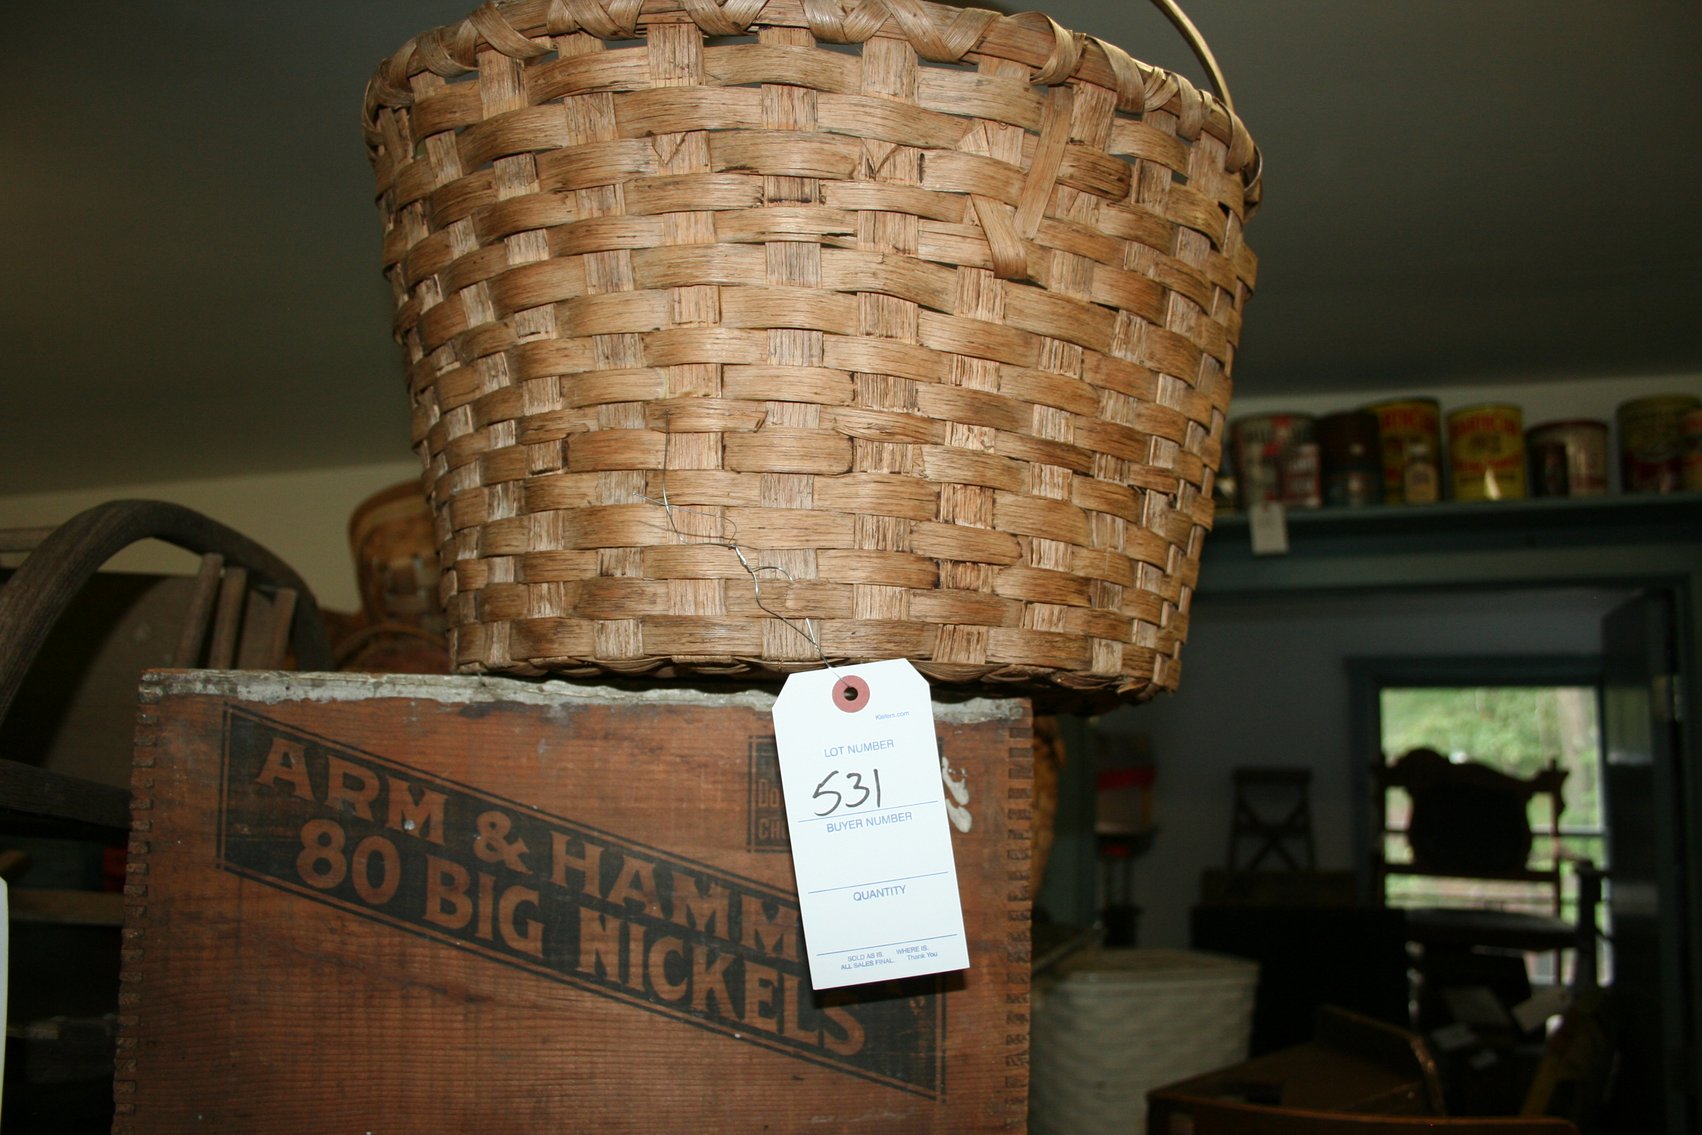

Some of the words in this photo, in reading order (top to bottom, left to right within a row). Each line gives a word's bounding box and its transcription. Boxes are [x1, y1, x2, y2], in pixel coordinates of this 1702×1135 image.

[823, 745, 845, 758] LOT
[847, 739, 895, 755] NUMBER
[812, 768, 881, 817] 531
[826, 819, 864, 833] BUYER
[865, 811, 913, 827] NUMBER
[255, 737, 450, 847] ARM
[473, 810, 534, 875] &
[549, 830, 800, 961] HAMM
[852, 885, 907, 902] QUANTITY
[296, 818, 400, 905] 80
[422, 854, 545, 958] BIG
[576, 906, 865, 1056] NICKELS
[840, 961, 853, 970] ALL
[853, 959, 874, 969] SALES
[907, 953, 926, 961] Thank
[926, 951, 938, 959] You
[847, 953, 865, 962] SOLD
[866, 952, 876, 960] AS
[896, 946, 919, 955] WHERE
